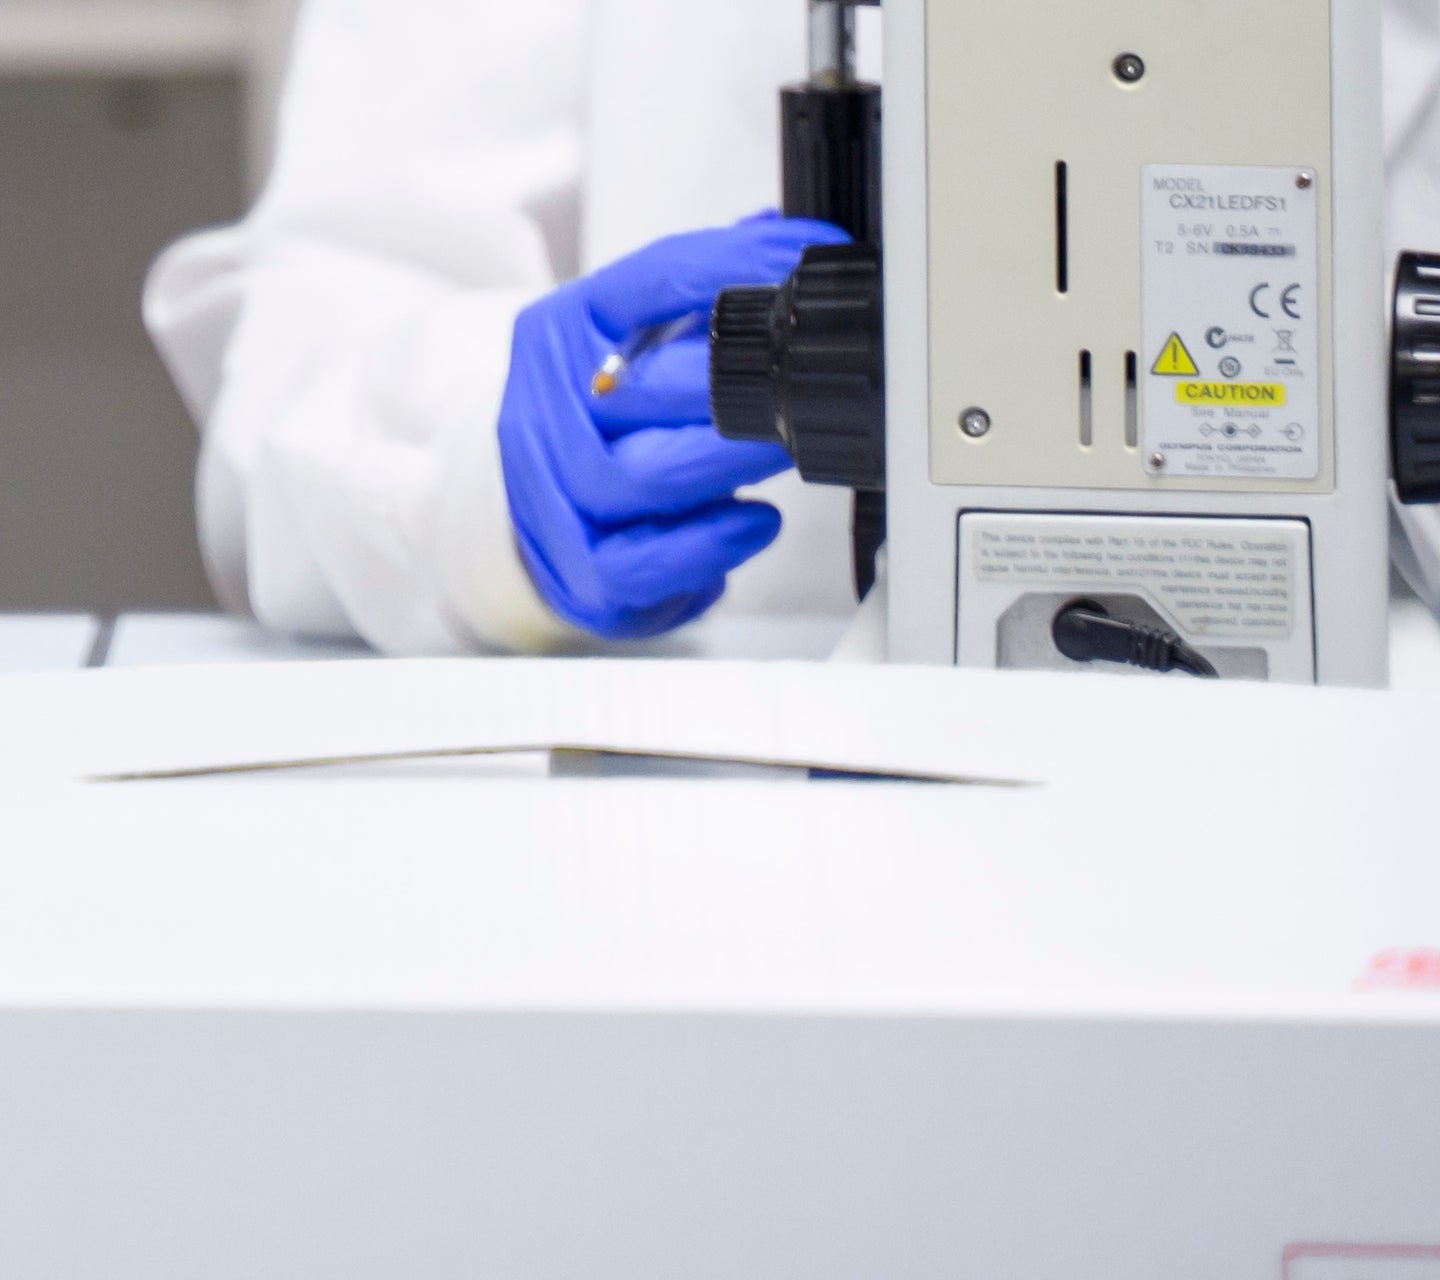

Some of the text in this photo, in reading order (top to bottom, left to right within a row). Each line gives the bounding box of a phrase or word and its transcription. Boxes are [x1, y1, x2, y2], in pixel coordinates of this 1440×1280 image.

[1153, 178, 1204, 191] MODEL
[1169, 193, 1287, 211] CX21LEDFS1
[1154, 241, 1174, 254] T2
[1185, 241, 1209, 254] SN
[1185, 383, 1274, 400] CAUTION
[1190, 406, 1269, 419] See Manual
[1159, 442, 1302, 453] OLYMPUS CORPORATION
